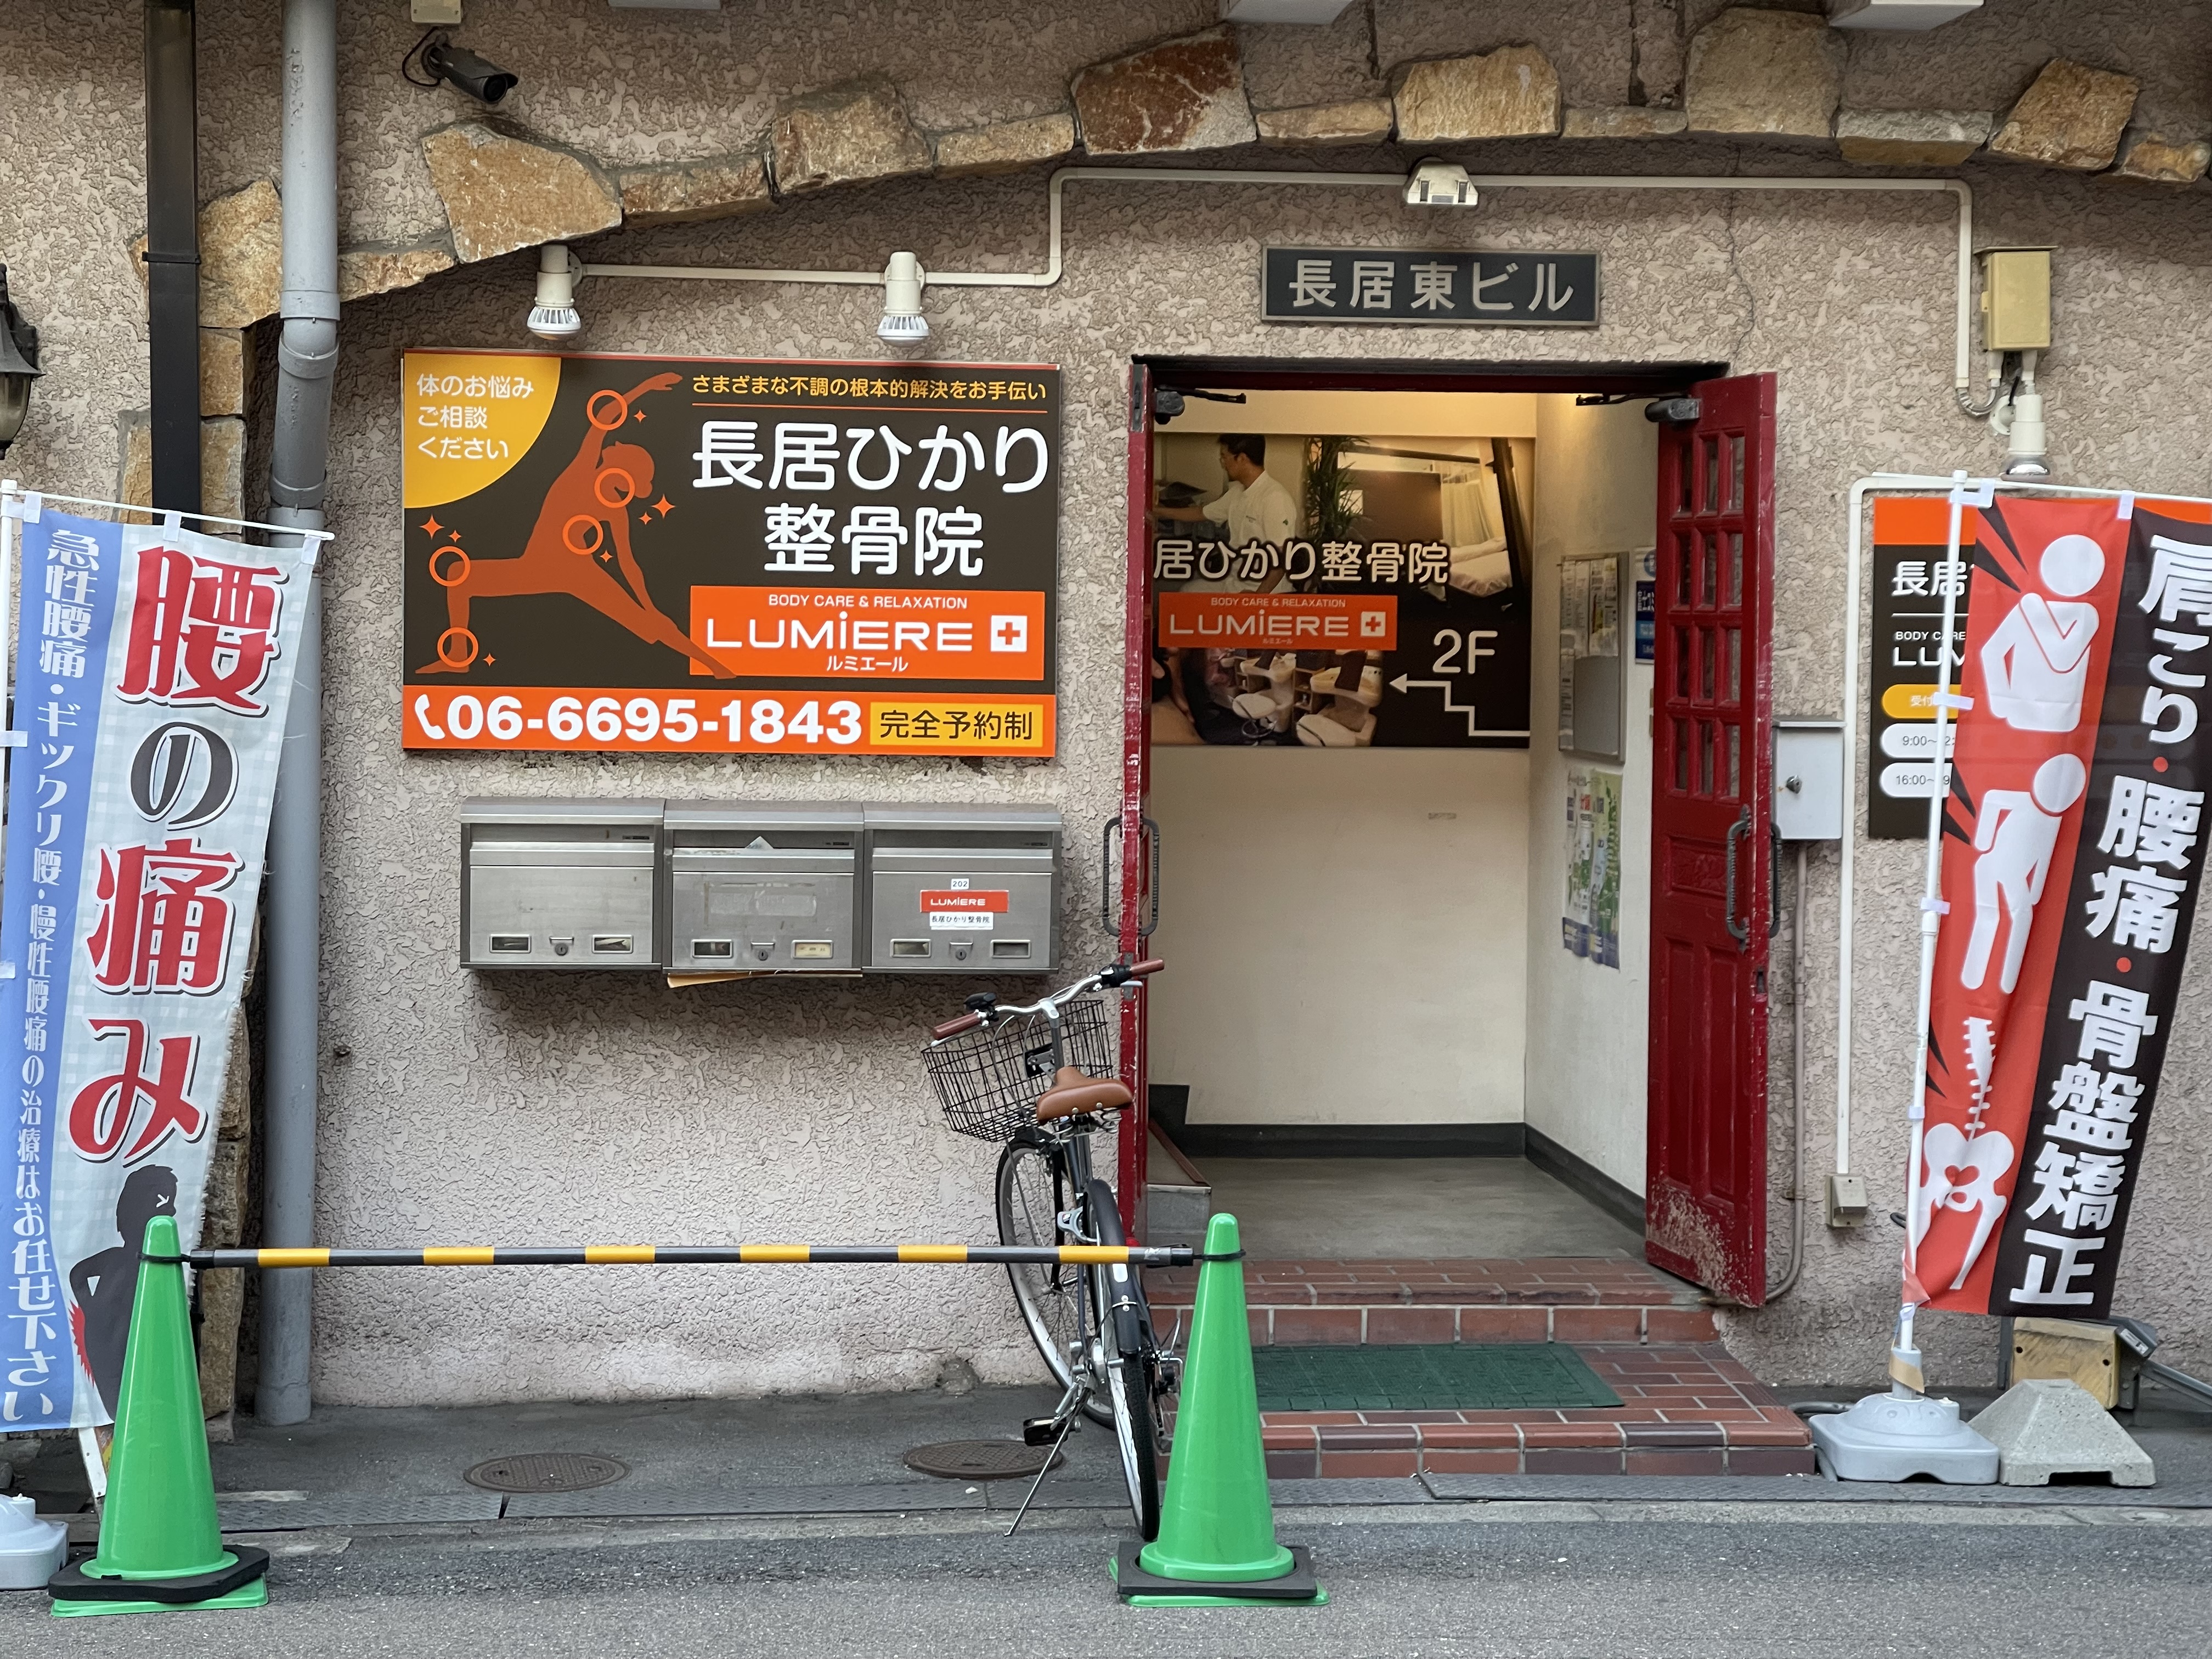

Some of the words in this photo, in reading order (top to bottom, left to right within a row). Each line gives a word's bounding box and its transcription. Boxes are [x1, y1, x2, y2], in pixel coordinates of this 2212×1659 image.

[1289, 259, 1573, 312] 長居東ビル
[416, 374, 534, 398] 体のお悩み
[692, 374, 1047, 400] さまざまな不調の根本的解決をお手伝い
[418, 405, 488, 429] ご相談
[418, 436, 509, 459] ください
[692, 421, 1048, 493] 長居ひかり
[764, 505, 984, 576] 整骨院
[1154, 539, 1449, 583] 居ひかり整骨院
[1892, 561, 1974, 596] 長居
[769, 594, 809, 606] BODY
[814, 595, 854, 607] CARE
[859, 596, 869, 607] &
[873, 596, 967, 609] RELAXATION
[1211, 597, 1238, 606] BODY
[1242, 598, 1268, 606] CARE
[1282, 599, 1346, 607] RELAXATION
[1432, 629, 1498, 674] 2F
[1895, 631, 1929, 641] BODY
[1933, 631, 1966, 641] CRE
[826, 655, 909, 672] ルミエール
[447, 695, 862, 744] 06-6695-1843
[880, 709, 1032, 740] 完全予約制
[67, 543, 283, 1162] 腰の痛み
[932, 915, 990, 924] 長居ひかり整骨院
[2010, 534, 2212, 1306] 肩こり・腰痛・骨盤矯正
